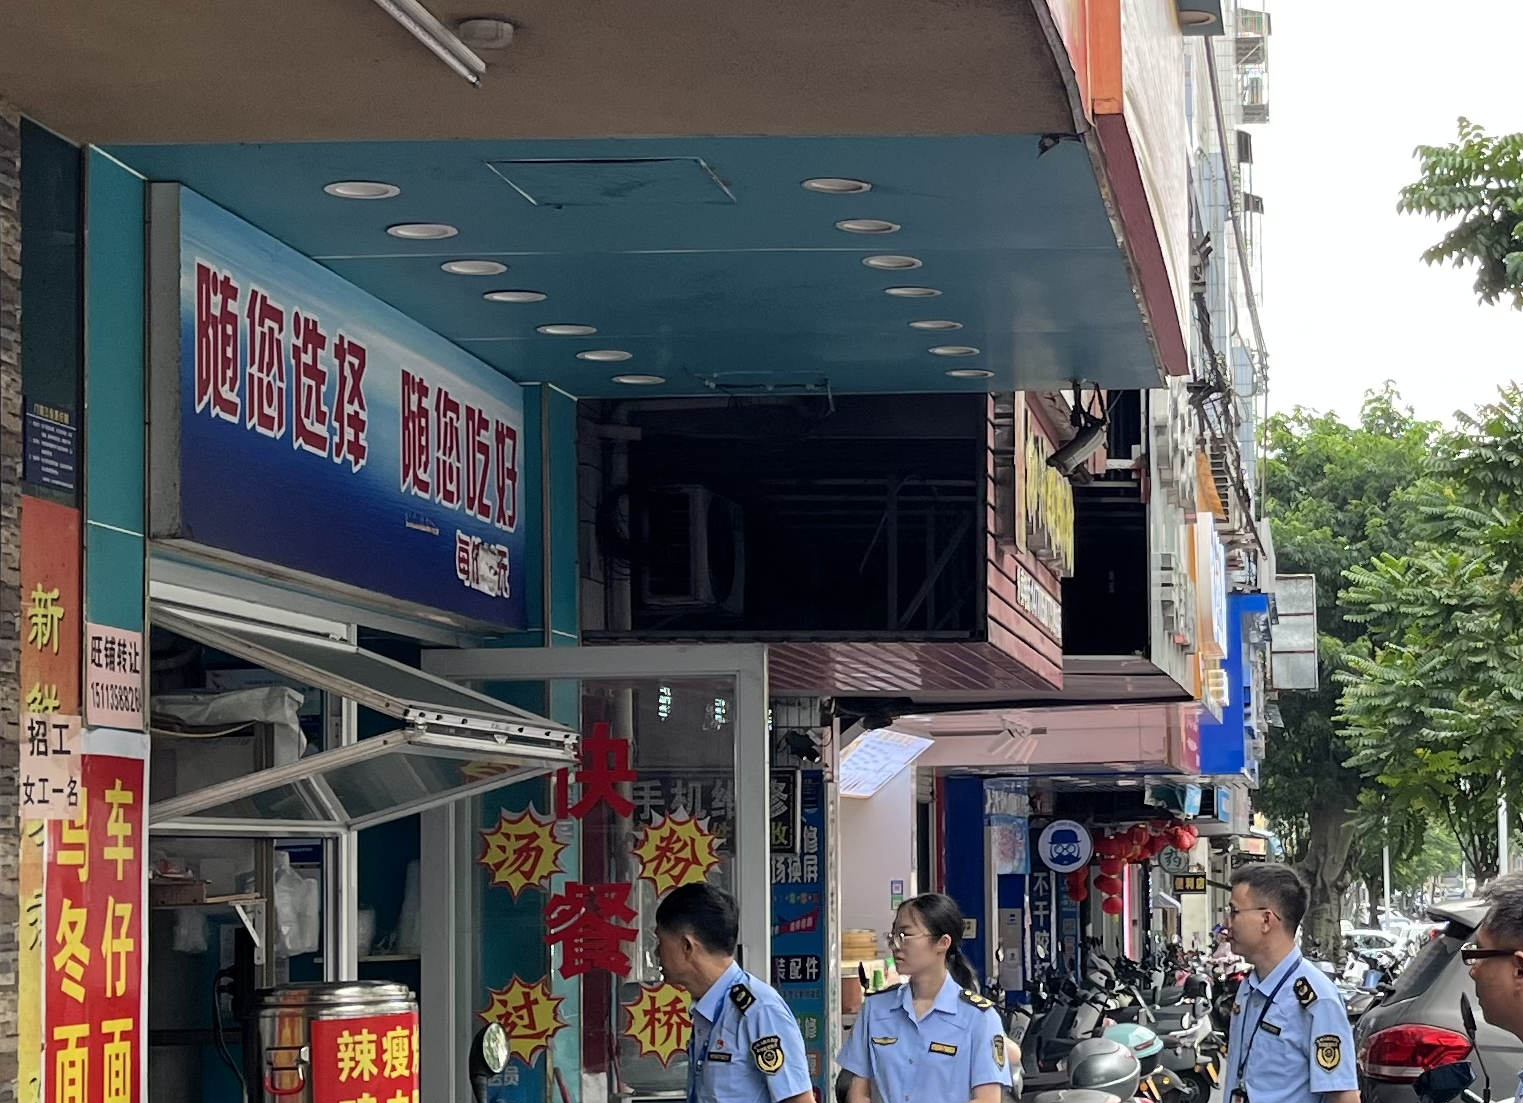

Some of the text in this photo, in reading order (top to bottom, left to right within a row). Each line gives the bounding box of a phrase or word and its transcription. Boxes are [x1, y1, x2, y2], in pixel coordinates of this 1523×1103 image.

[195, 258, 517, 533] 随您选择 随您吃好
[90, 635, 140, 674] 旺铺转让
[27, 718, 72, 756] 招工
[23, 775, 79, 808] 女工一名
[495, 826, 704, 888] 汤 粉
[544, 722, 639, 980] 快餐
[495, 990, 694, 1049] 过 桥
